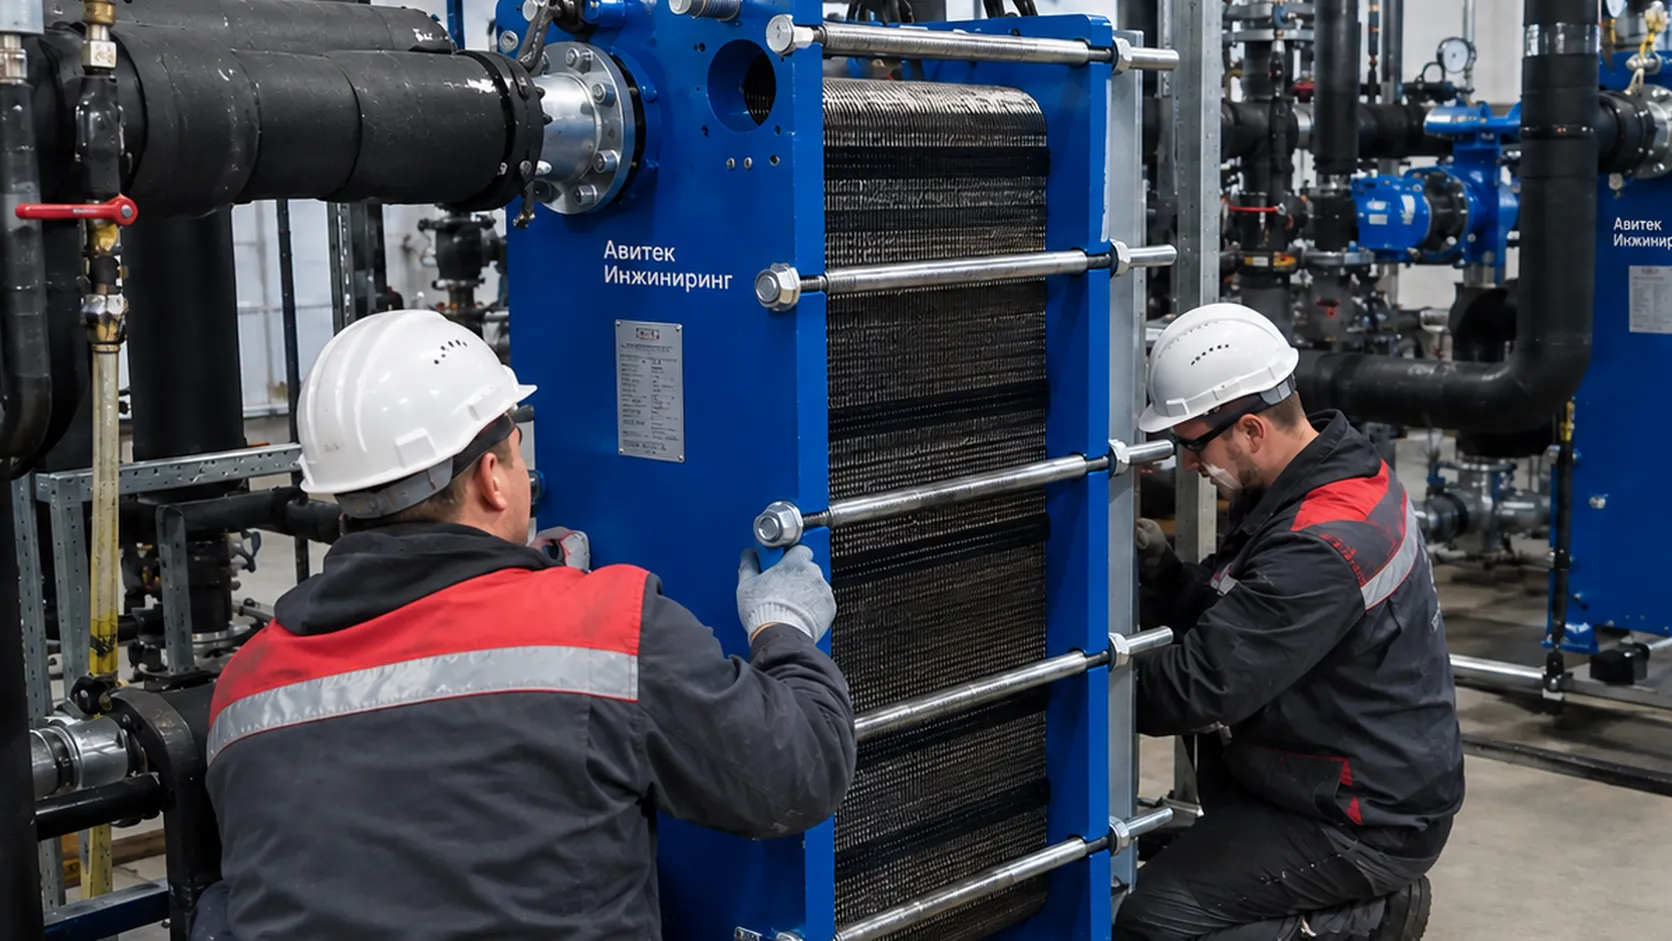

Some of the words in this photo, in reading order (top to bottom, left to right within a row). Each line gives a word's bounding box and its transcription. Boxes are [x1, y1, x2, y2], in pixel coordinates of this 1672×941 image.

[1613, 216, 1662, 231] Авитек
[604, 240, 675, 262] Авитек
[604, 264, 733, 293] Инжиниринг
